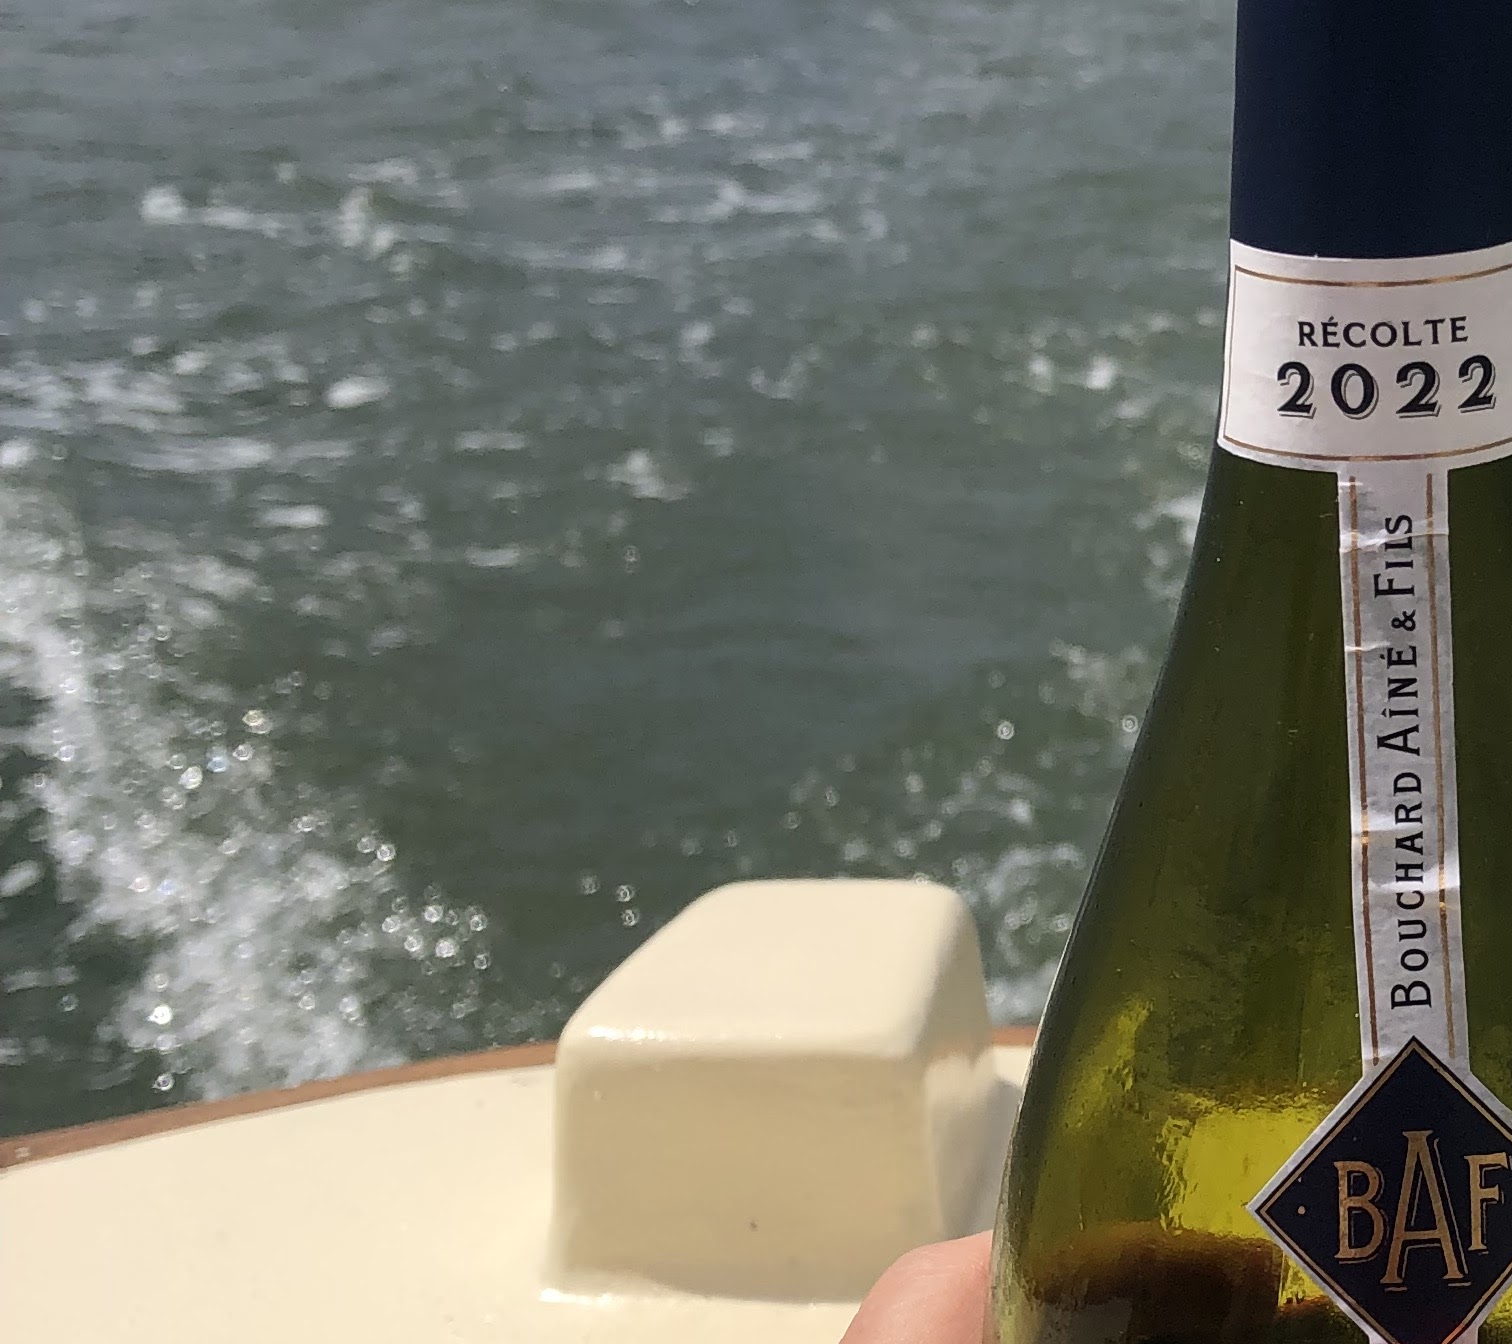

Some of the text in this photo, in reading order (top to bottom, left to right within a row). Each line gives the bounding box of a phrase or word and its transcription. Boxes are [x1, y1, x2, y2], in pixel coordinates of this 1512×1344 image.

[1297, 316, 1470, 348] RÉCOLTE
[1276, 354, 1498, 420] 2022
[1373, 513, 1415, 599] FILS
[1390, 610, 1418, 632] &
[1390, 772, 1432, 1010] BOUCHARD
[1333, 1129, 1512, 1292] BAF
